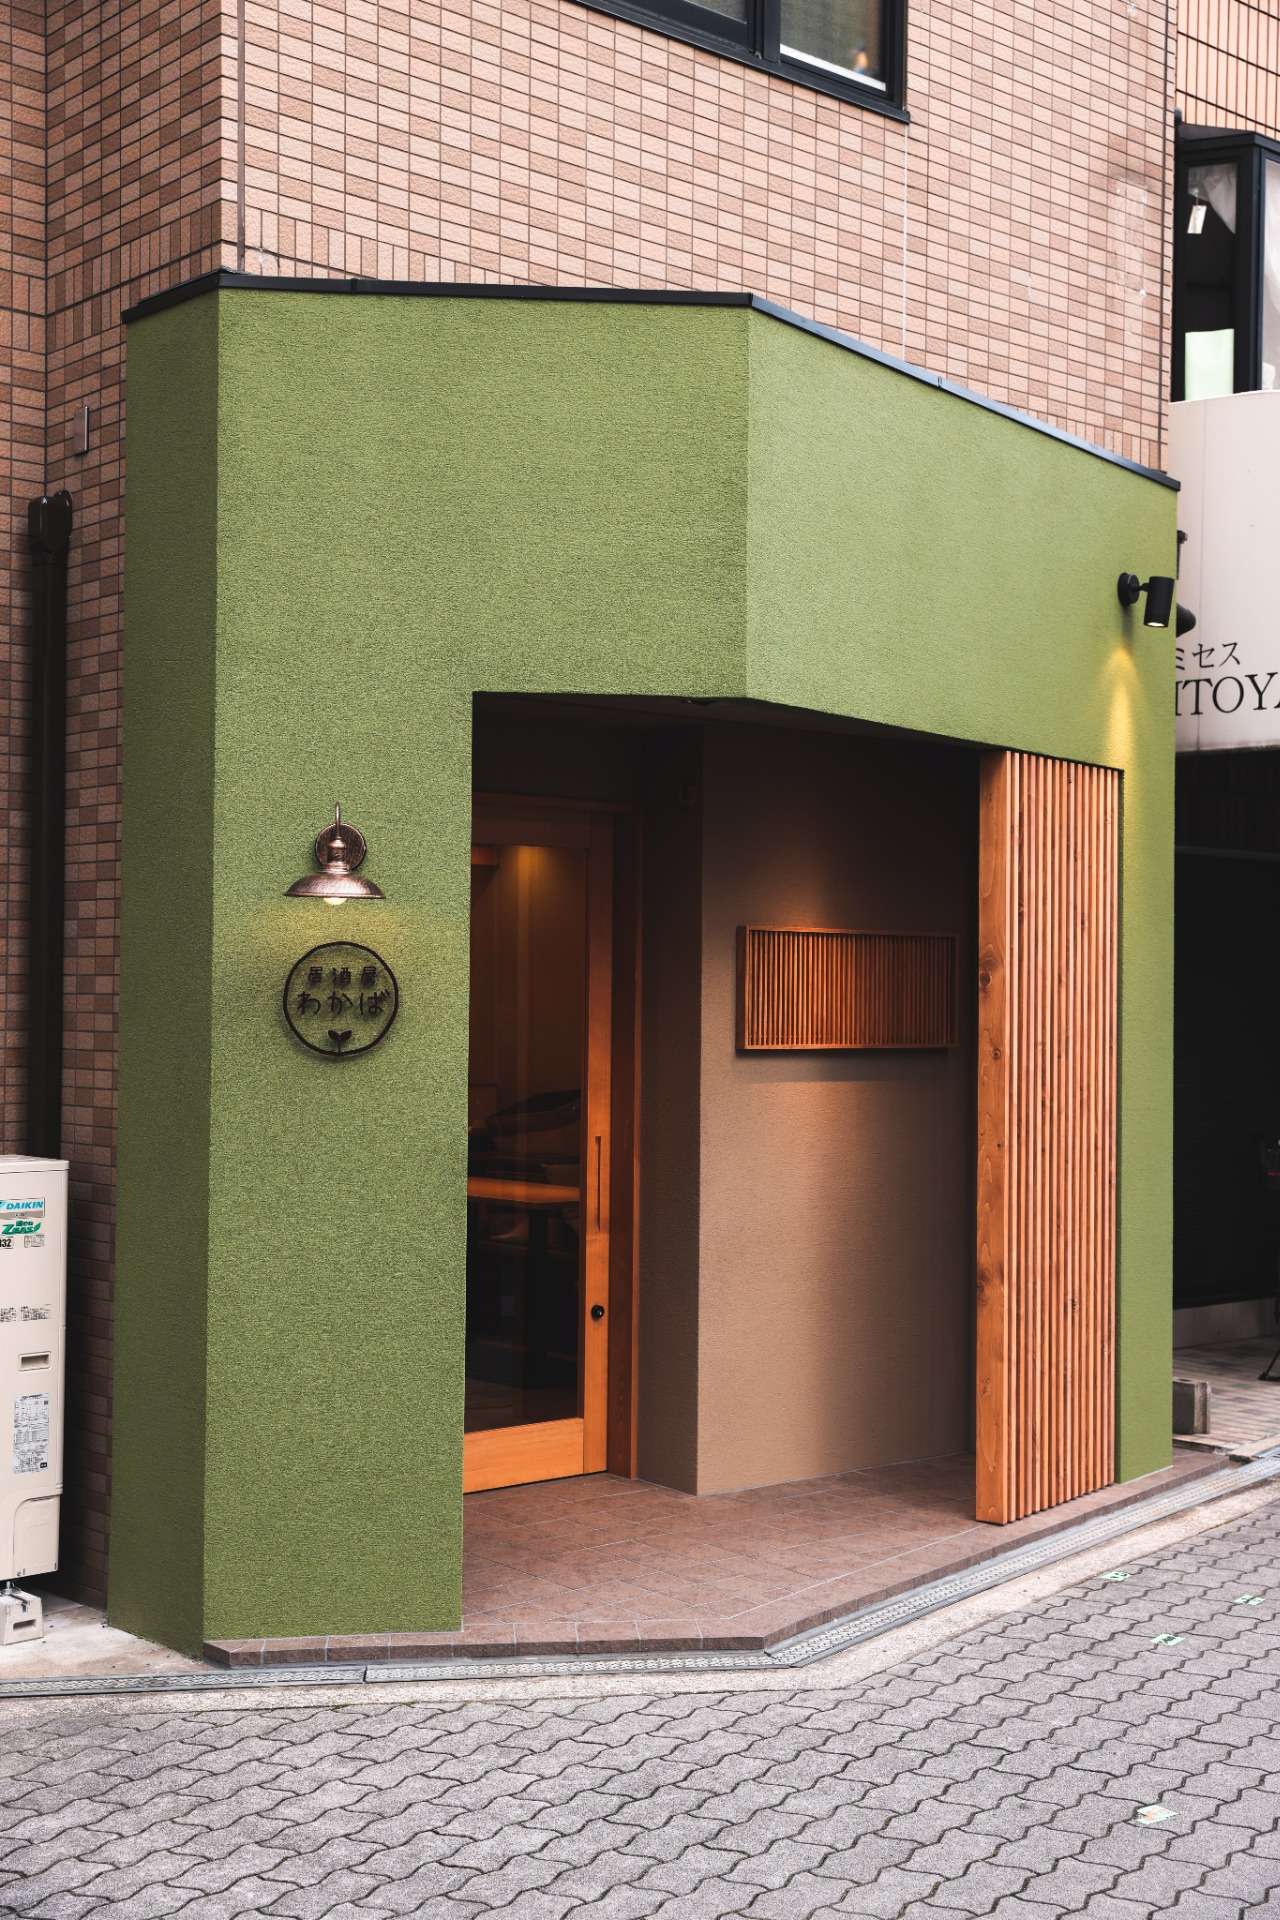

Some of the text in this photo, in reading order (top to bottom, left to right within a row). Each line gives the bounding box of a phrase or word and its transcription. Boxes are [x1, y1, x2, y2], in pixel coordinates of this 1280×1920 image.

[1176, 672, 1280, 716] ITOY
[297, 989, 391, 1015] わかば
